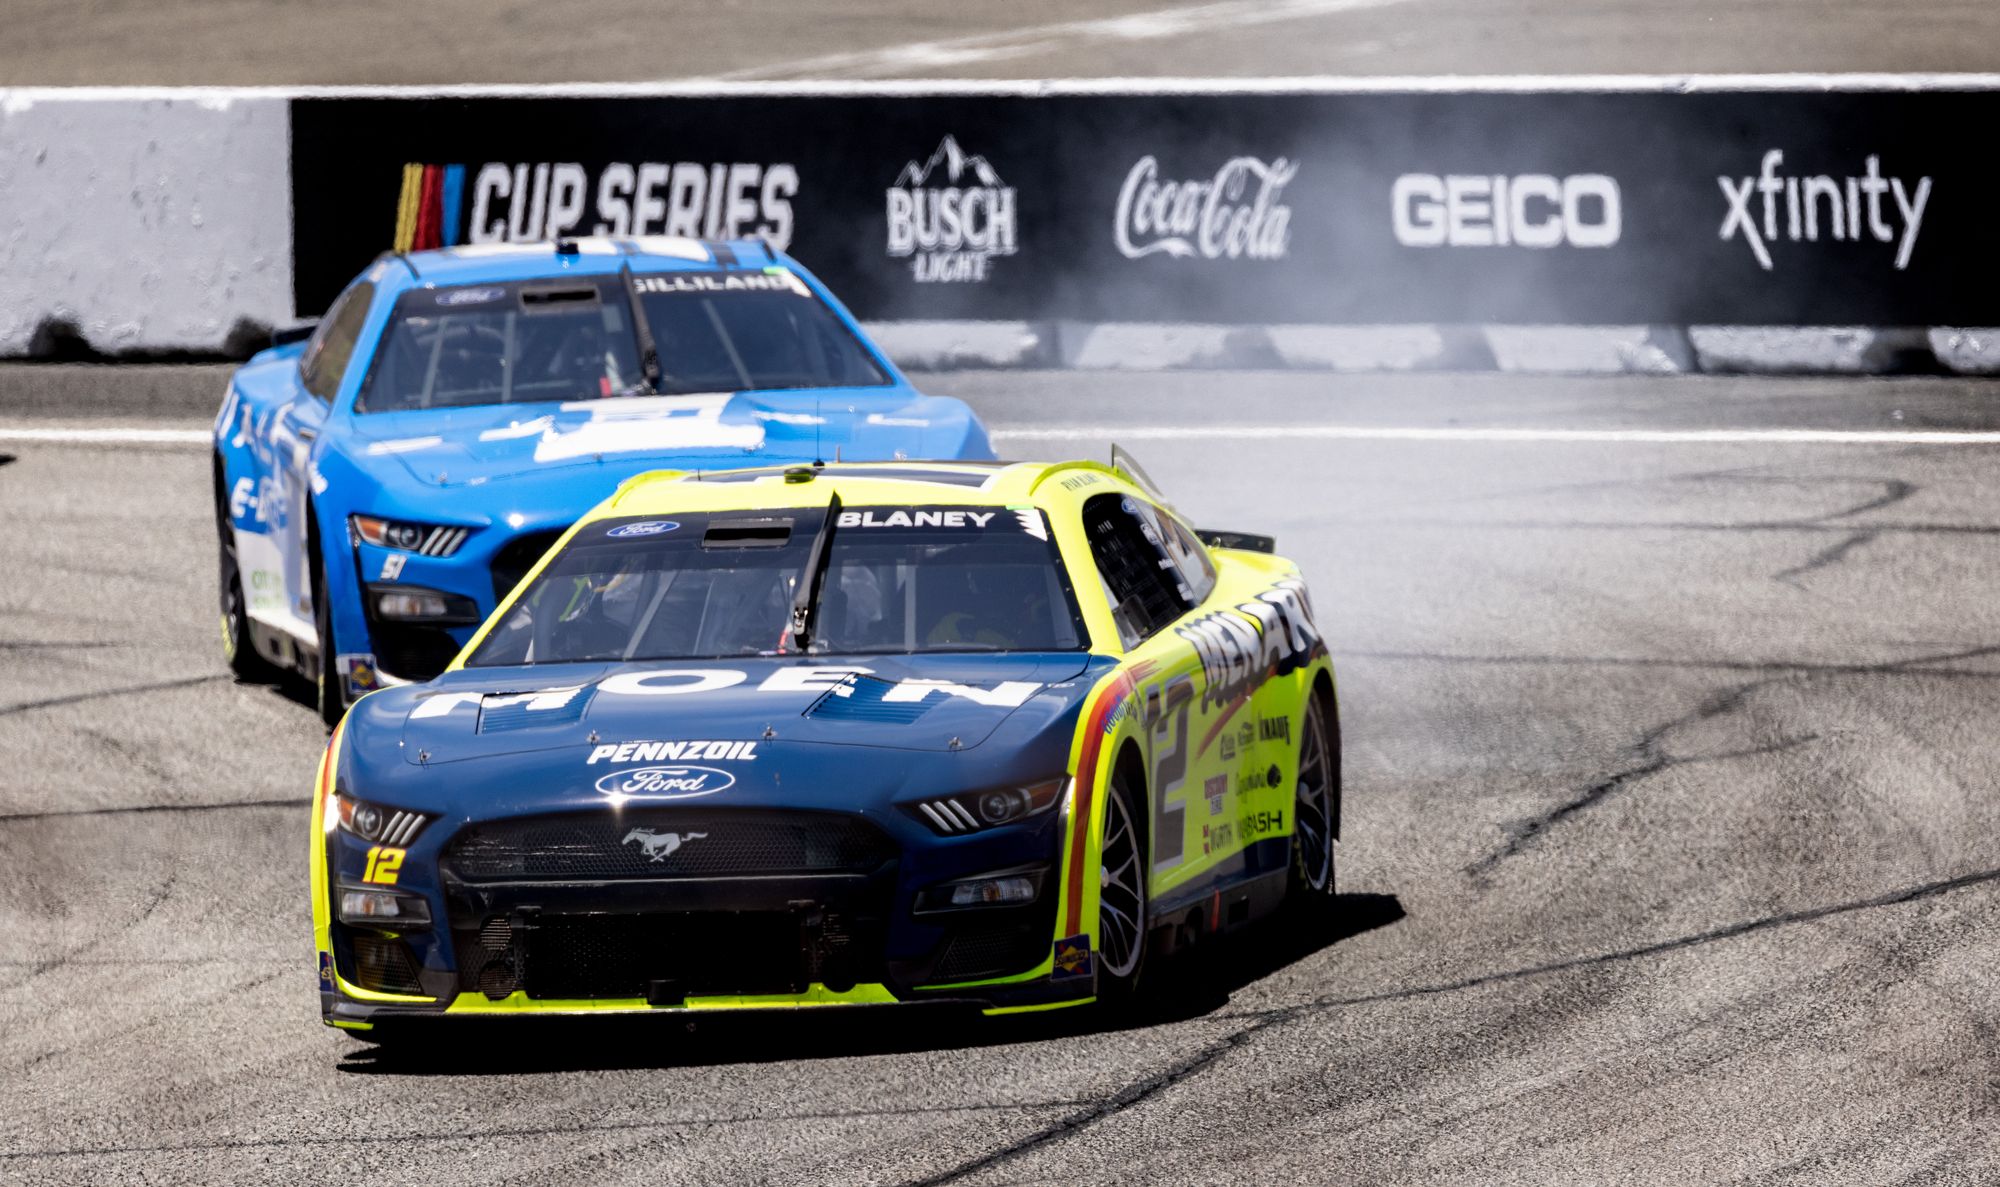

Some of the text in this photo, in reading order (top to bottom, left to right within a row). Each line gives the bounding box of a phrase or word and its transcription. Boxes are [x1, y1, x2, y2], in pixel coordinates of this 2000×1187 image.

[471, 163, 799, 249] CUP SERIES
[887, 187, 1016, 254] BUSCH
[1391, 174, 1622, 247] GEICO
[1719, 150, 1932, 269] xfinity
[915, 252, 991, 282] LIGHT
[622, 521, 664, 535] Ford
[838, 511, 996, 528] BLANEY
[410, 665, 1044, 718] MOEN
[586, 741, 757, 765] PENNZOIL
[1146, 672, 1194, 873] 2
[621, 766, 705, 794] Ford
[362, 847, 406, 884] 12
